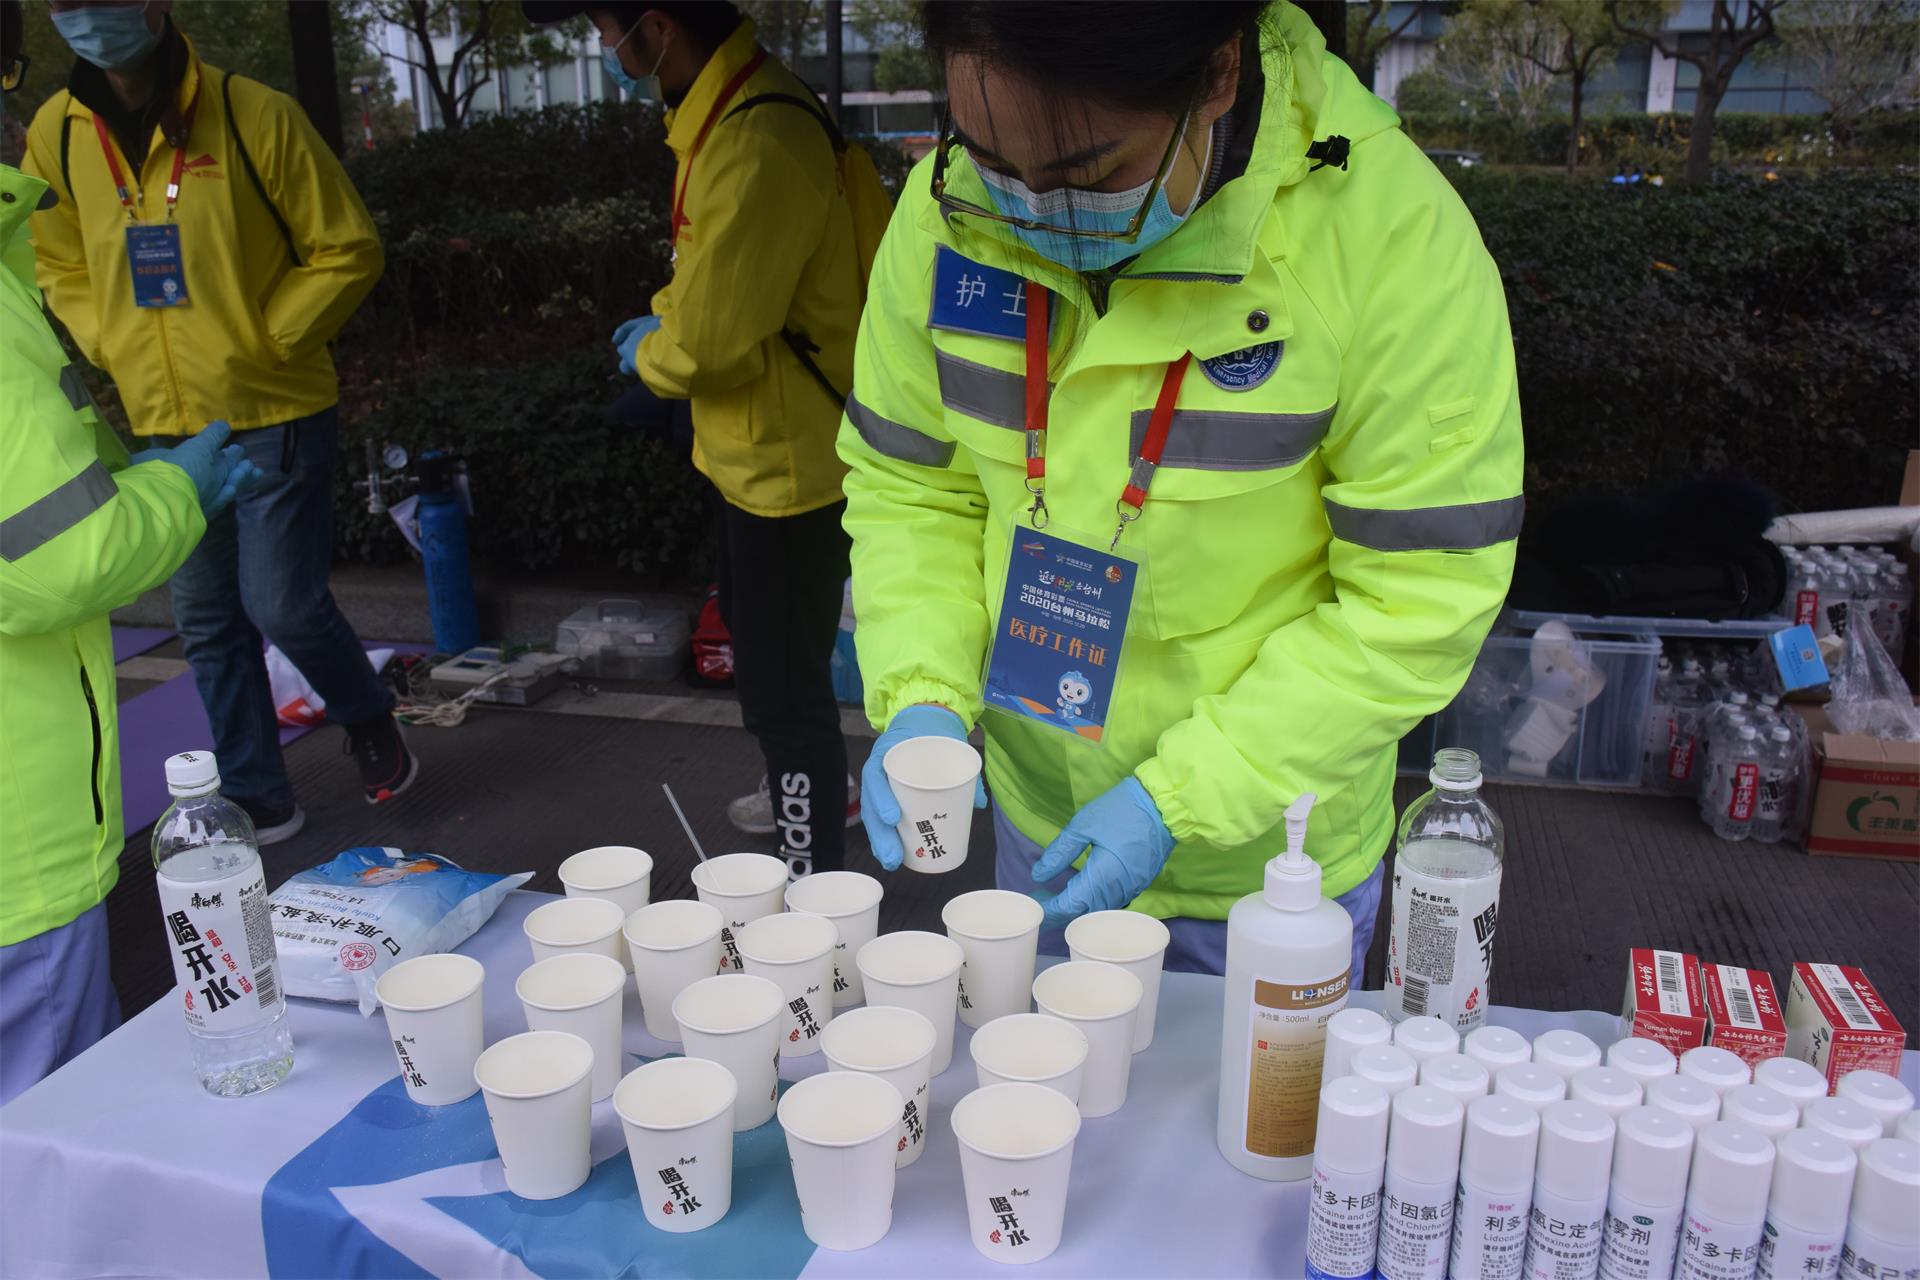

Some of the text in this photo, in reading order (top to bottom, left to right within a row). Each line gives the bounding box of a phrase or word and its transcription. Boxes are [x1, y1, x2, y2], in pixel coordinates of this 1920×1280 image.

[1213, 365, 1246, 385] Emergency
[1247, 361, 1269, 383] Medical
[1020, 592, 1111, 630] 2020台州马拉松
[1022, 583, 1066, 604] 中国体育彩票
[1008, 616, 1109, 668] 医疗工作证
[777, 772, 813, 886] didas
[915, 819, 947, 860] 喝开水
[190, 891, 224, 910] 康师傅
[166, 910, 241, 1013] 喝开水
[788, 996, 821, 1040] 喝开水
[1643, 1022, 1693, 1038] Yunnan Baiyao
[393, 1039, 428, 1088] 喝开水
[902, 1099, 924, 1145] 喝开水
[658, 1166, 703, 1216] 喝开水
[1312, 1180, 1377, 1211] 利多卡因
[988, 1195, 1032, 1247] 喝开水
[1611, 1234, 1650, 1258] Aerosol
[1685, 1228, 1759, 1263] 利多卡因
